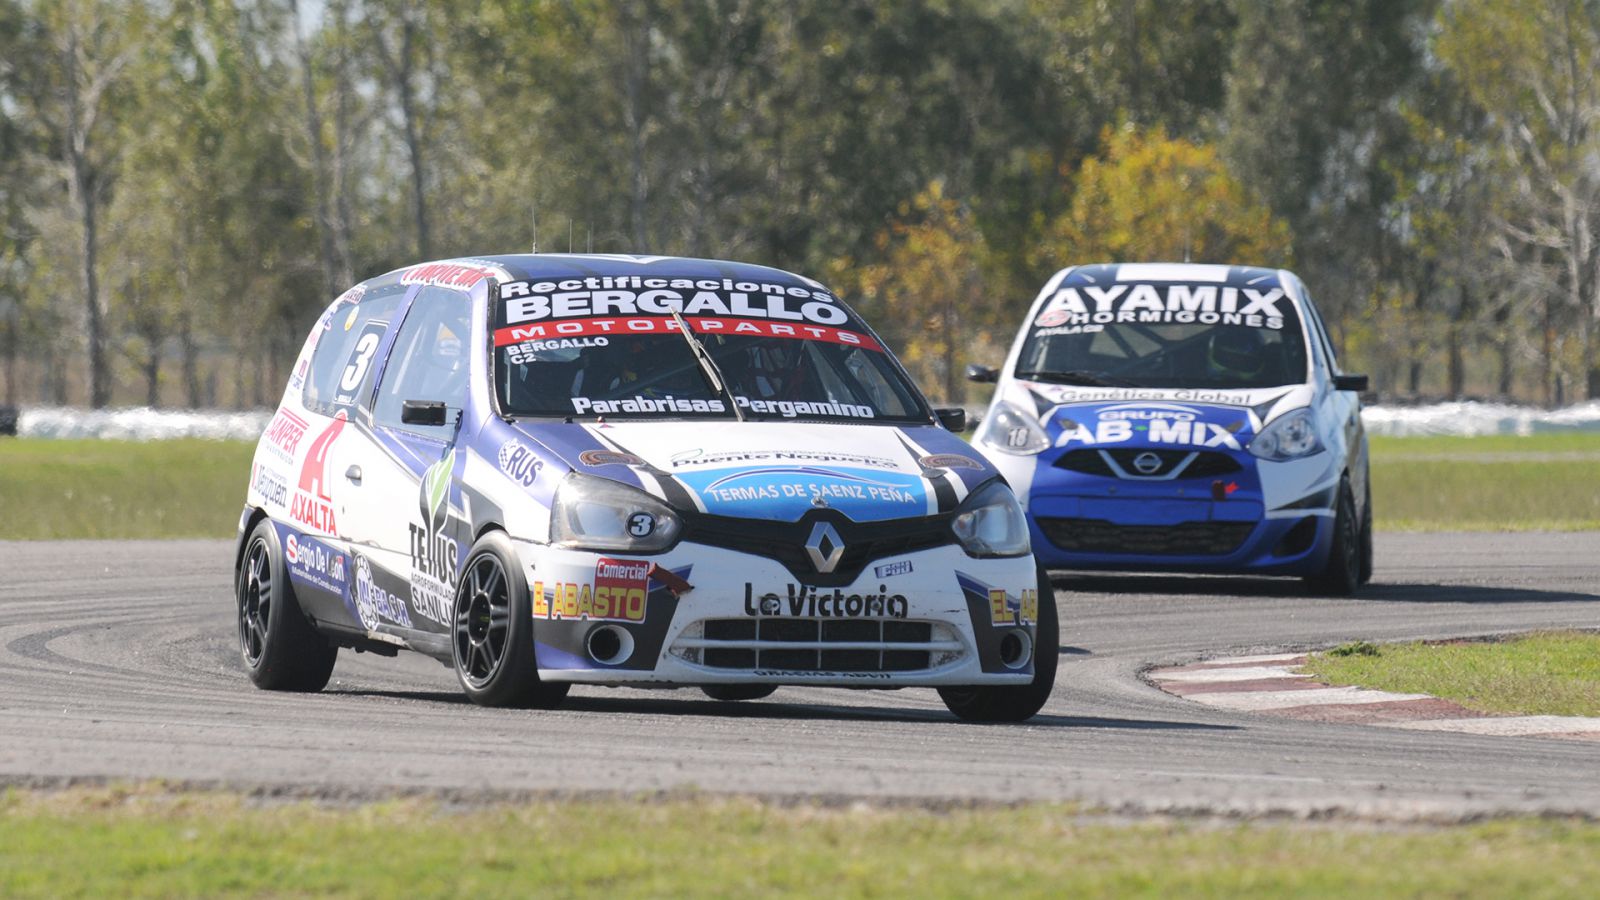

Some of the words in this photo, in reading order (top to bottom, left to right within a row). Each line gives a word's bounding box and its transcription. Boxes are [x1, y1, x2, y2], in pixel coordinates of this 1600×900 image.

[501, 276, 834, 303] Rectificaciones
[1040, 285, 1286, 317] AYAMIX
[506, 289, 849, 325] BERGALLO
[1070, 309, 1284, 330] HORMIGONES
[506, 336, 609, 357] BERGALLO
[509, 352, 536, 366] C2
[340, 332, 380, 391] 3
[571, 396, 726, 414] Parabrisas
[733, 396, 875, 418] Pergamino
[1060, 389, 1164, 402] Genética
[1174, 390, 1251, 406] Global
[1098, 410, 1196, 422] GRUPO
[505, 445, 544, 488] RUS
[671, 453, 770, 468] Puente
[710, 486, 780, 503] TERMAS
[783, 485, 807, 498] DE
[811, 486, 867, 499] SAENZ
[871, 485, 917, 504] PEÑA
[289, 491, 337, 537] AXALTA
[629, 514, 651, 537] 3
[286, 534, 315, 573] Sergio
[316, 546, 326, 574] De
[596, 561, 649, 581] Comercial
[532, 580, 549, 617] EL
[552, 582, 646, 621] ABASTO
[744, 582, 781, 617] La
[787, 583, 909, 619] Victoria
[989, 588, 1015, 624] EL
